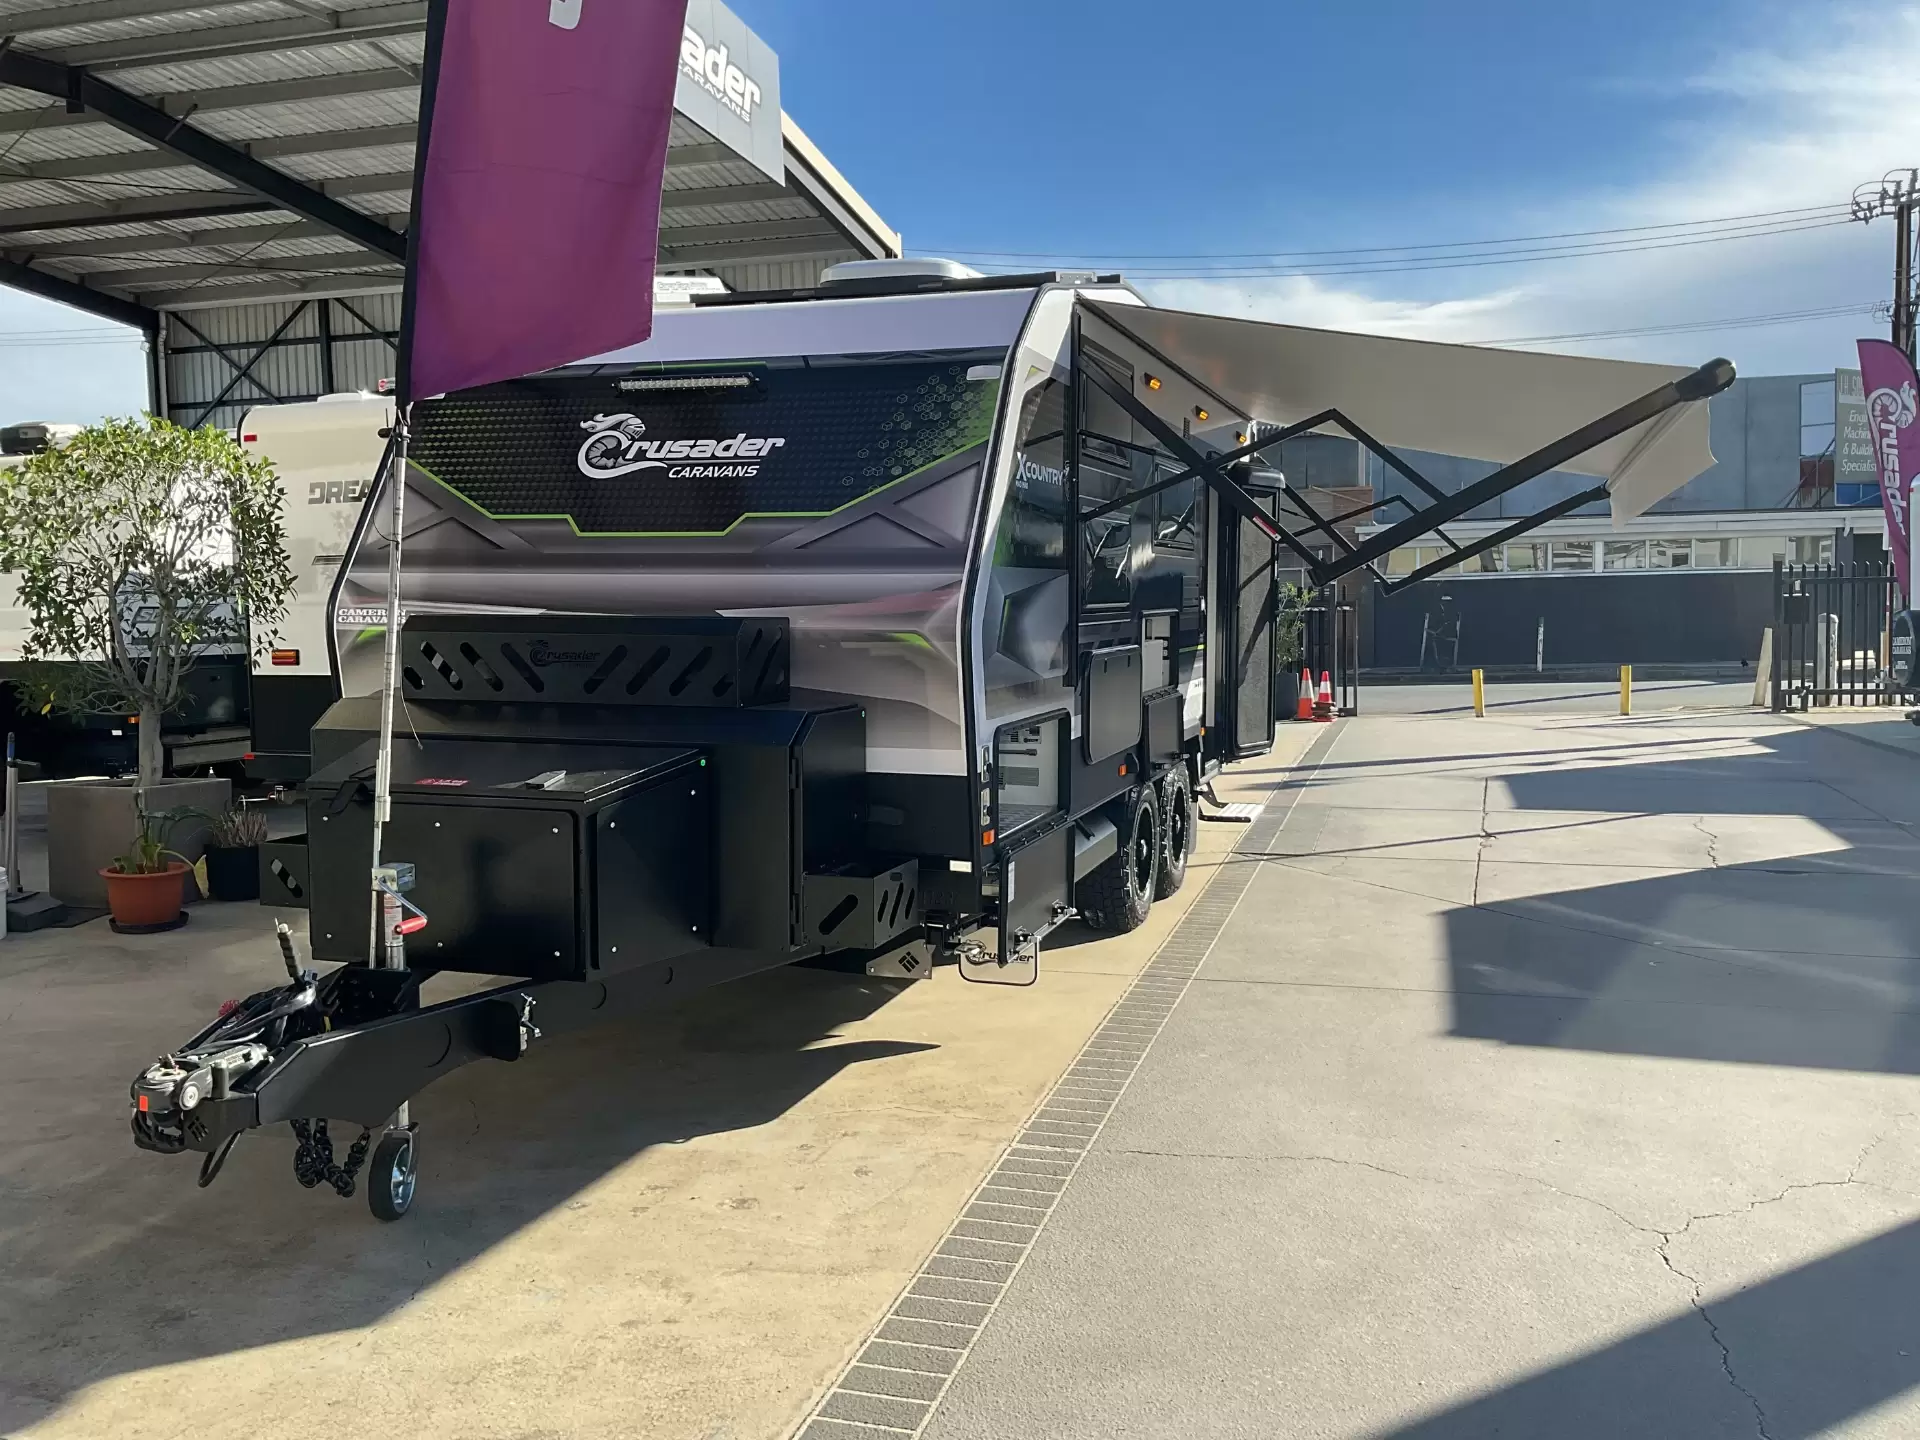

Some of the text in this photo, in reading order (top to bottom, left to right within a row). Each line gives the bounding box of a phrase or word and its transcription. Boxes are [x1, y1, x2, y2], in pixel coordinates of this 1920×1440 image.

[577, 430, 786, 479] Crusader
[1843, 443, 1849, 455] &
[667, 465, 760, 479] CARAVANS
[338, 608, 406, 616] CAMERN
[338, 615, 406, 624] CARAVAS
